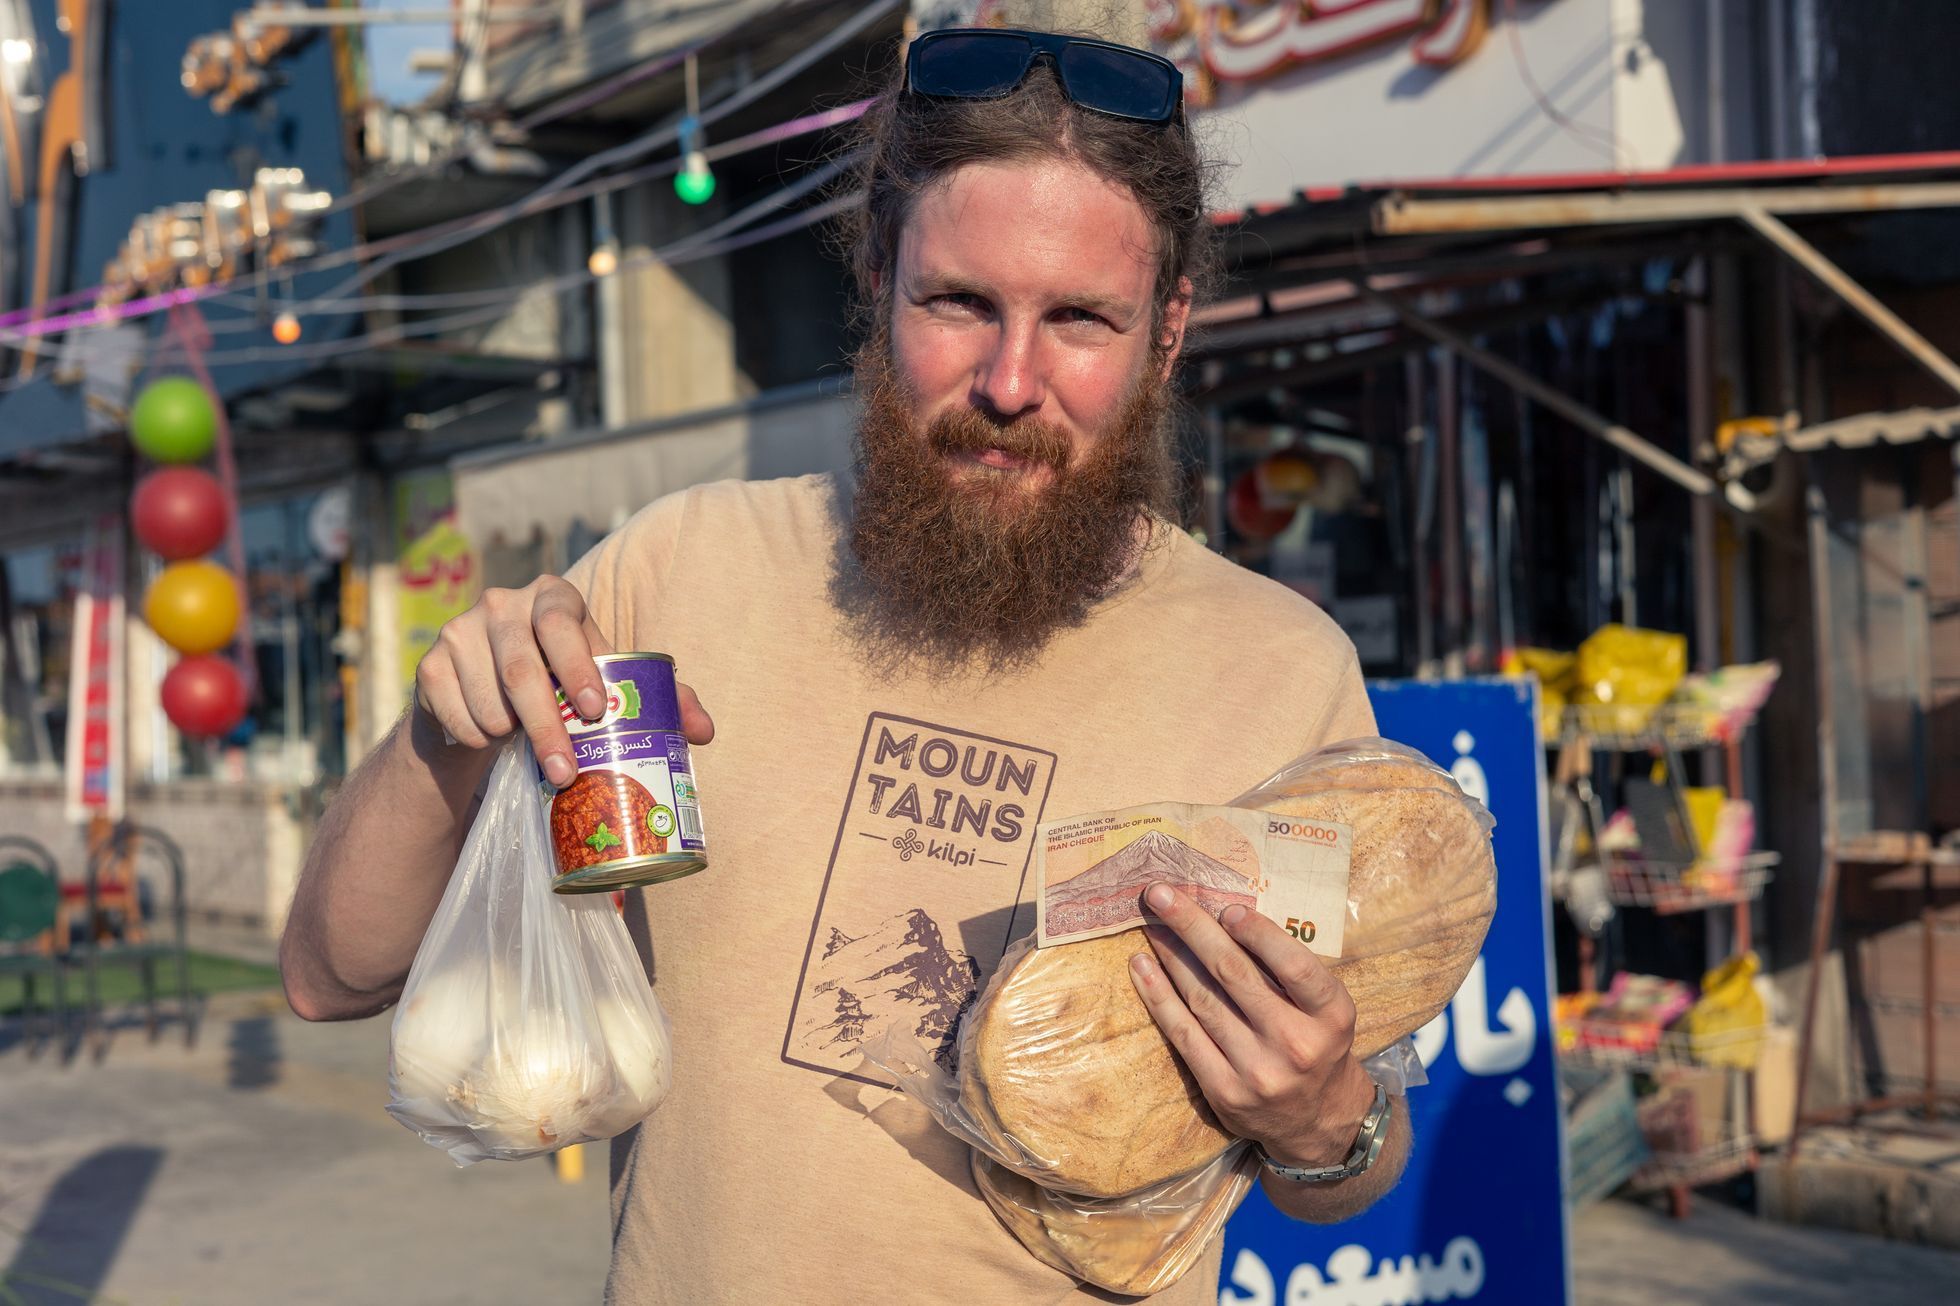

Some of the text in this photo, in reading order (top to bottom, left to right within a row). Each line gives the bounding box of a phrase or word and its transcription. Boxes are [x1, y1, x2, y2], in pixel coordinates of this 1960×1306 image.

[874, 726, 1038, 796] MOUN
[868, 773, 1025, 842] TAINS
[1048, 823, 1081, 836] CENTRAL
[1083, 818, 1104, 828] BANK
[1048, 817, 1162, 843] THE ISLAMIC REPUBLIC OF IRAN
[1268, 821, 1338, 842] 500000
[926, 839, 977, 867] kilpi
[1047, 834, 1105, 852] IRAN CHEQUE
[1285, 917, 1316, 943] 50
